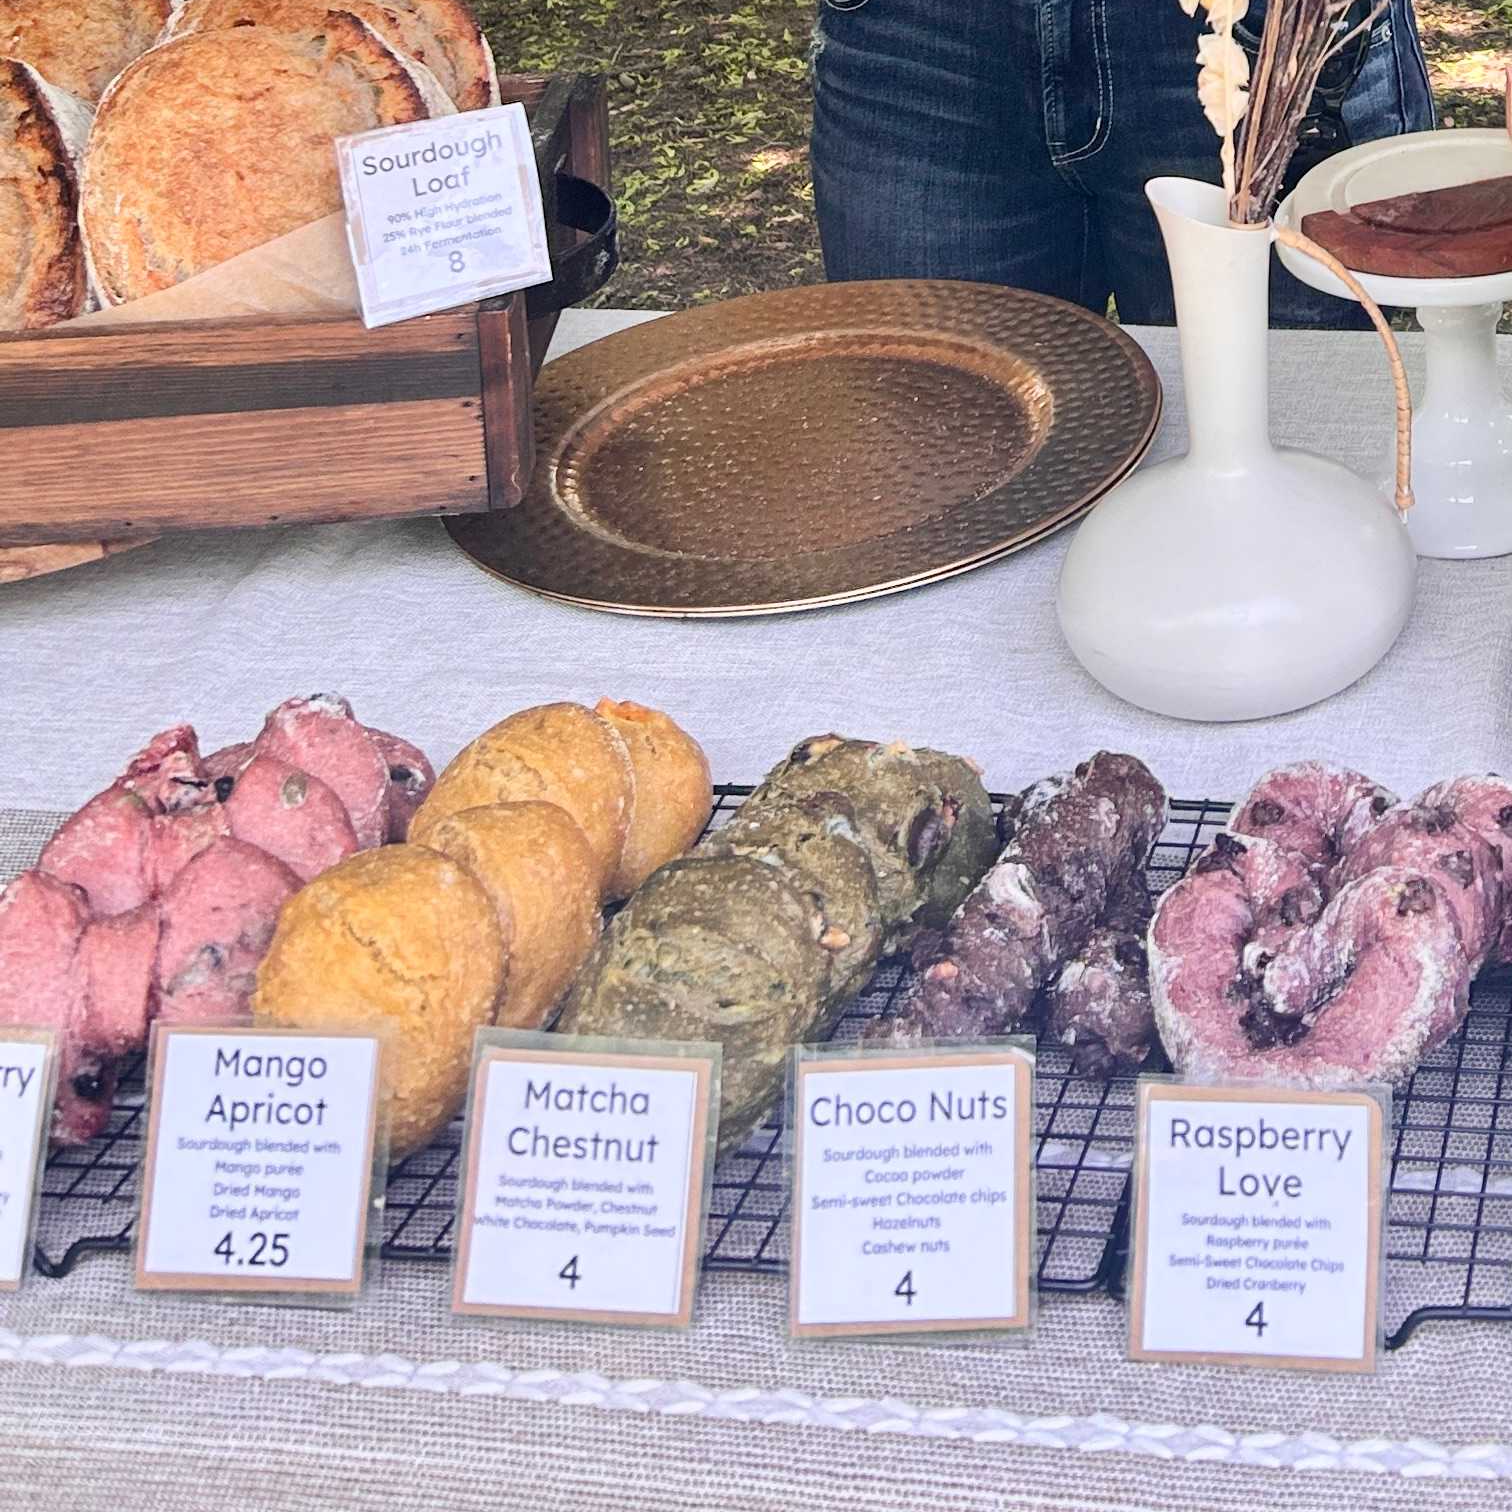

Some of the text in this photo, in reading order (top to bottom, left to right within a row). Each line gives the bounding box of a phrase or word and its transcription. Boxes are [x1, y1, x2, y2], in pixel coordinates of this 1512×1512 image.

[362, 131, 502, 177] Sourdough
[412, 165, 472, 196] Loaf
[387, 192, 502, 224] 90% Hydration
[449, 251, 465, 273] 8
[214, 1048, 328, 1086] Mango
[524, 1080, 650, 1115] Matcha
[811, 1090, 1007, 1126] Choco Nuts
[205, 1093, 328, 1130] Apricot
[176, 1137, 311, 1155] Sourdough blended
[508, 1126, 660, 1163] Chestnut
[1170, 1118, 1352, 1161] Raspberry
[824, 1142, 993, 1163] Sourdough blended with
[215, 1160, 261, 1177] Mango
[865, 1168, 965, 1184] Cocoa powder
[213, 1182, 300, 1201] Dried Mango
[499, 1174, 623, 1193] Sourdough blended
[1218, 1166, 1303, 1197] Love
[495, 1196, 658, 1215] Matcha Chestnut
[897, 1192, 966, 1206] Chocolate
[970, 1190, 1007, 1205] chips
[209, 1205, 299, 1223] Dried Apricot
[873, 1216, 941, 1230] Hazelnuts
[1182, 1213, 1331, 1230] Sourdough blended with
[585, 1221, 676, 1237] Pumpkin Seed
[214, 1231, 290, 1267] 4.25
[862, 1240, 950, 1255] Cashew nuts
[1206, 1235, 1269, 1251] Raspberry
[558, 1254, 582, 1289] 4
[1245, 1256, 1344, 1273] Chocolate Chips
[895, 1270, 917, 1306] 4
[1206, 1277, 1306, 1295] Dried Cranberry
[1245, 1301, 1268, 1337] 4
